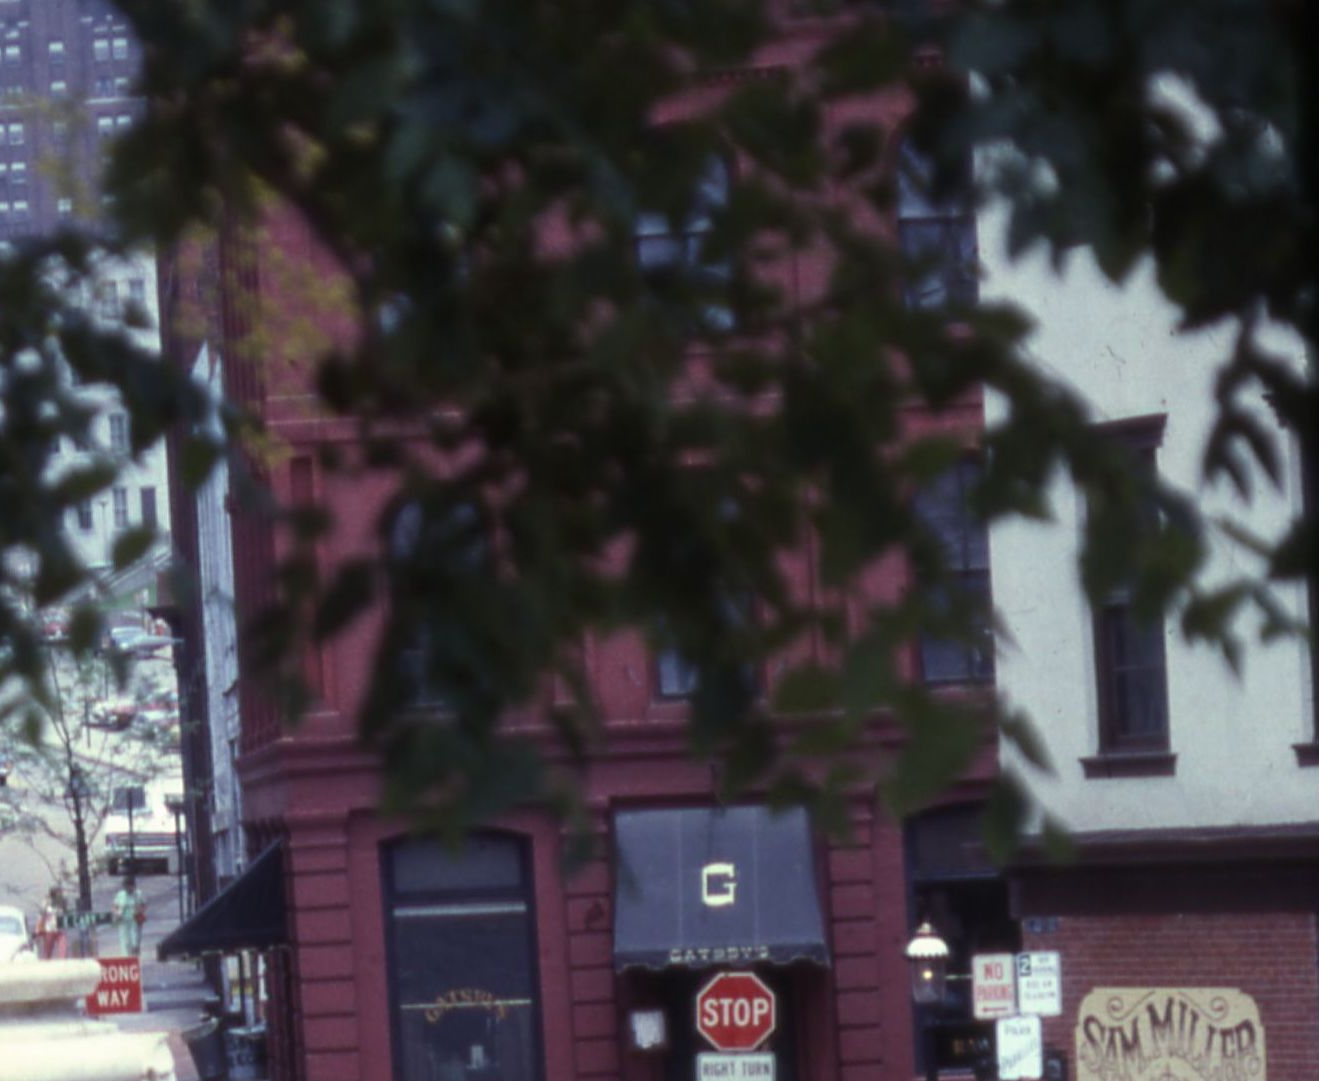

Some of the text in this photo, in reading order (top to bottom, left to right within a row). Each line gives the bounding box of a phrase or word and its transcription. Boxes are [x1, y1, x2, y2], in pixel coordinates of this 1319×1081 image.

[702, 863, 736, 906] G
[100, 965, 139, 982] RONG
[984, 963, 1003, 980] NO
[98, 989, 130, 1007] WAY
[703, 998, 769, 1027] STOP
[703, 1062, 770, 1075] RIGHT TURN
